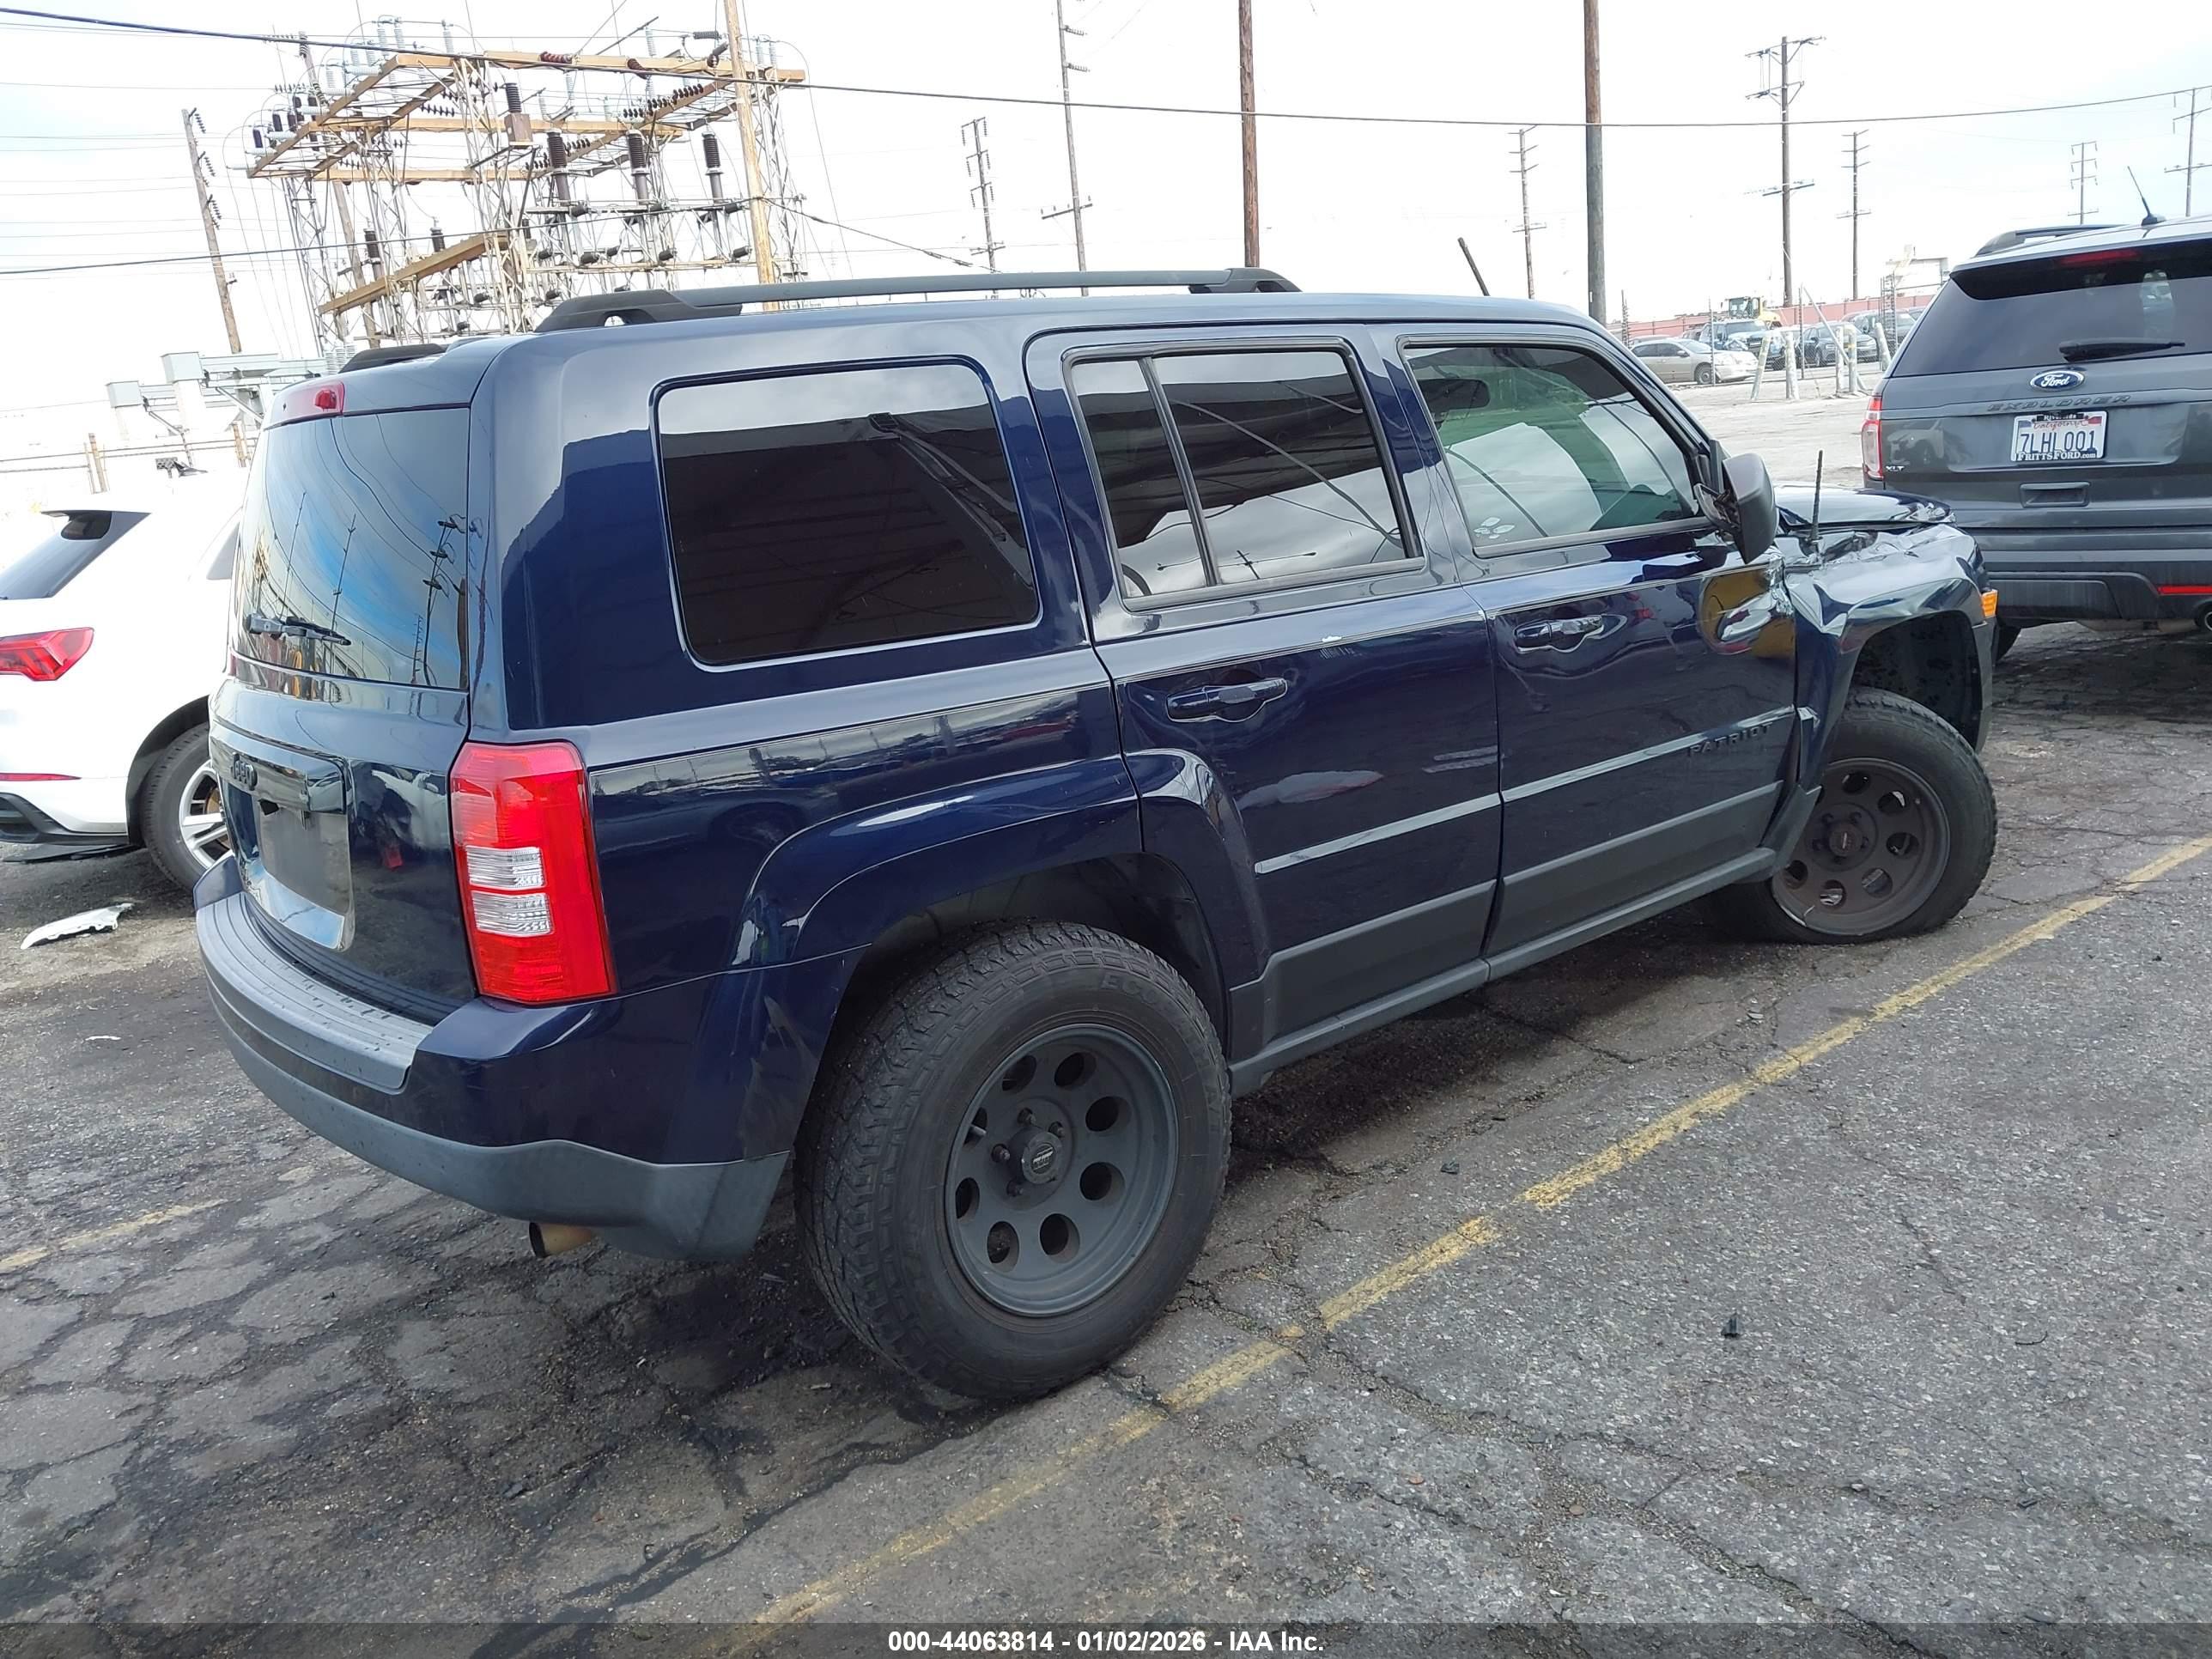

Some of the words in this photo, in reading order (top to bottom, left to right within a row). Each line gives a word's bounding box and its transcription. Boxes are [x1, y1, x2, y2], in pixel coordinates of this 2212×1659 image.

[2040, 373, 2071, 387] Ford
[1987, 394, 2131, 412] EXPLORER
[1688, 721, 1773, 757] PATRIOT
[233, 753, 258, 791] Jeep
